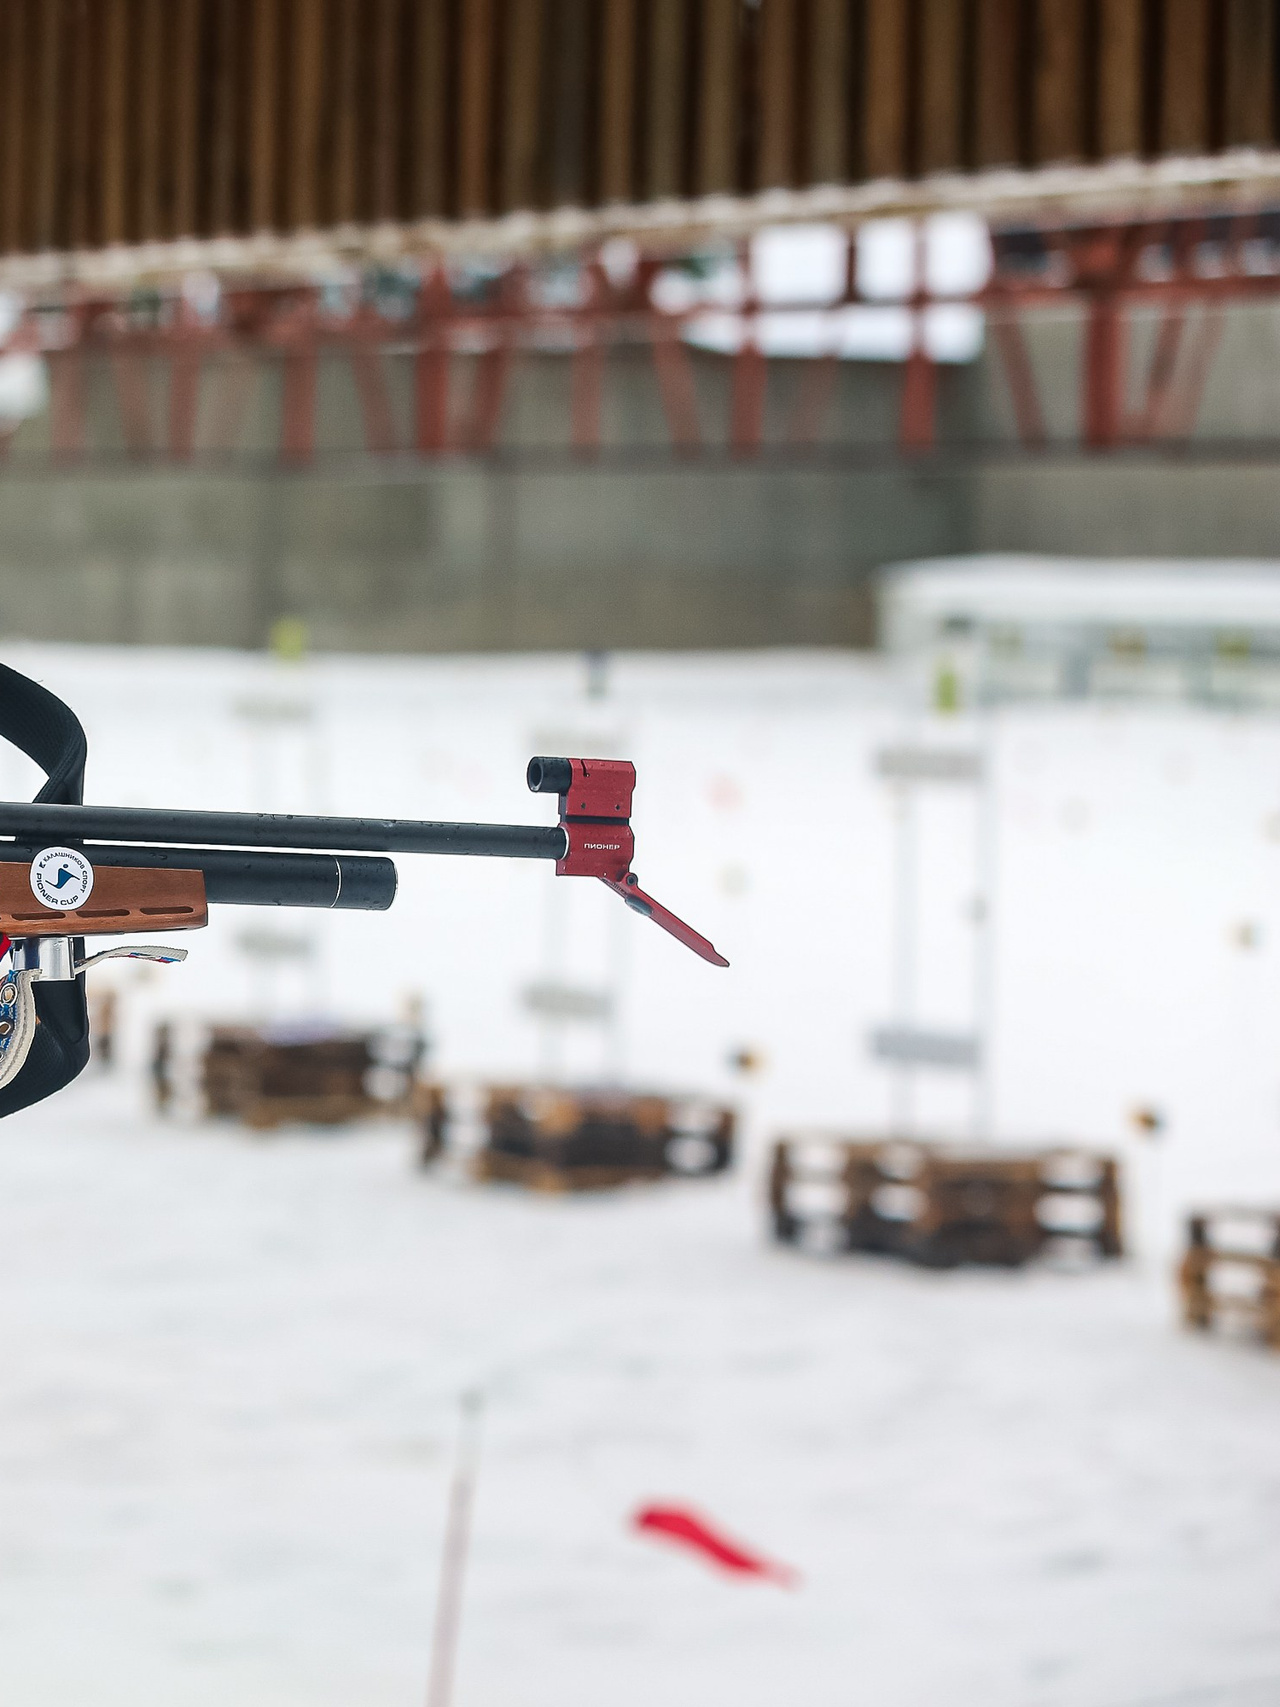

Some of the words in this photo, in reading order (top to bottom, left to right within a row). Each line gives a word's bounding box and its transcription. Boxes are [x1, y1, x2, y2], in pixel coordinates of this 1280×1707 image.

[36, 872, 59, 905] PIONER
[60, 894, 79, 906] CUP
[43, 852, 85, 869] КАЛАШНИКОВ
[80, 870, 88, 893] СПОРТ
